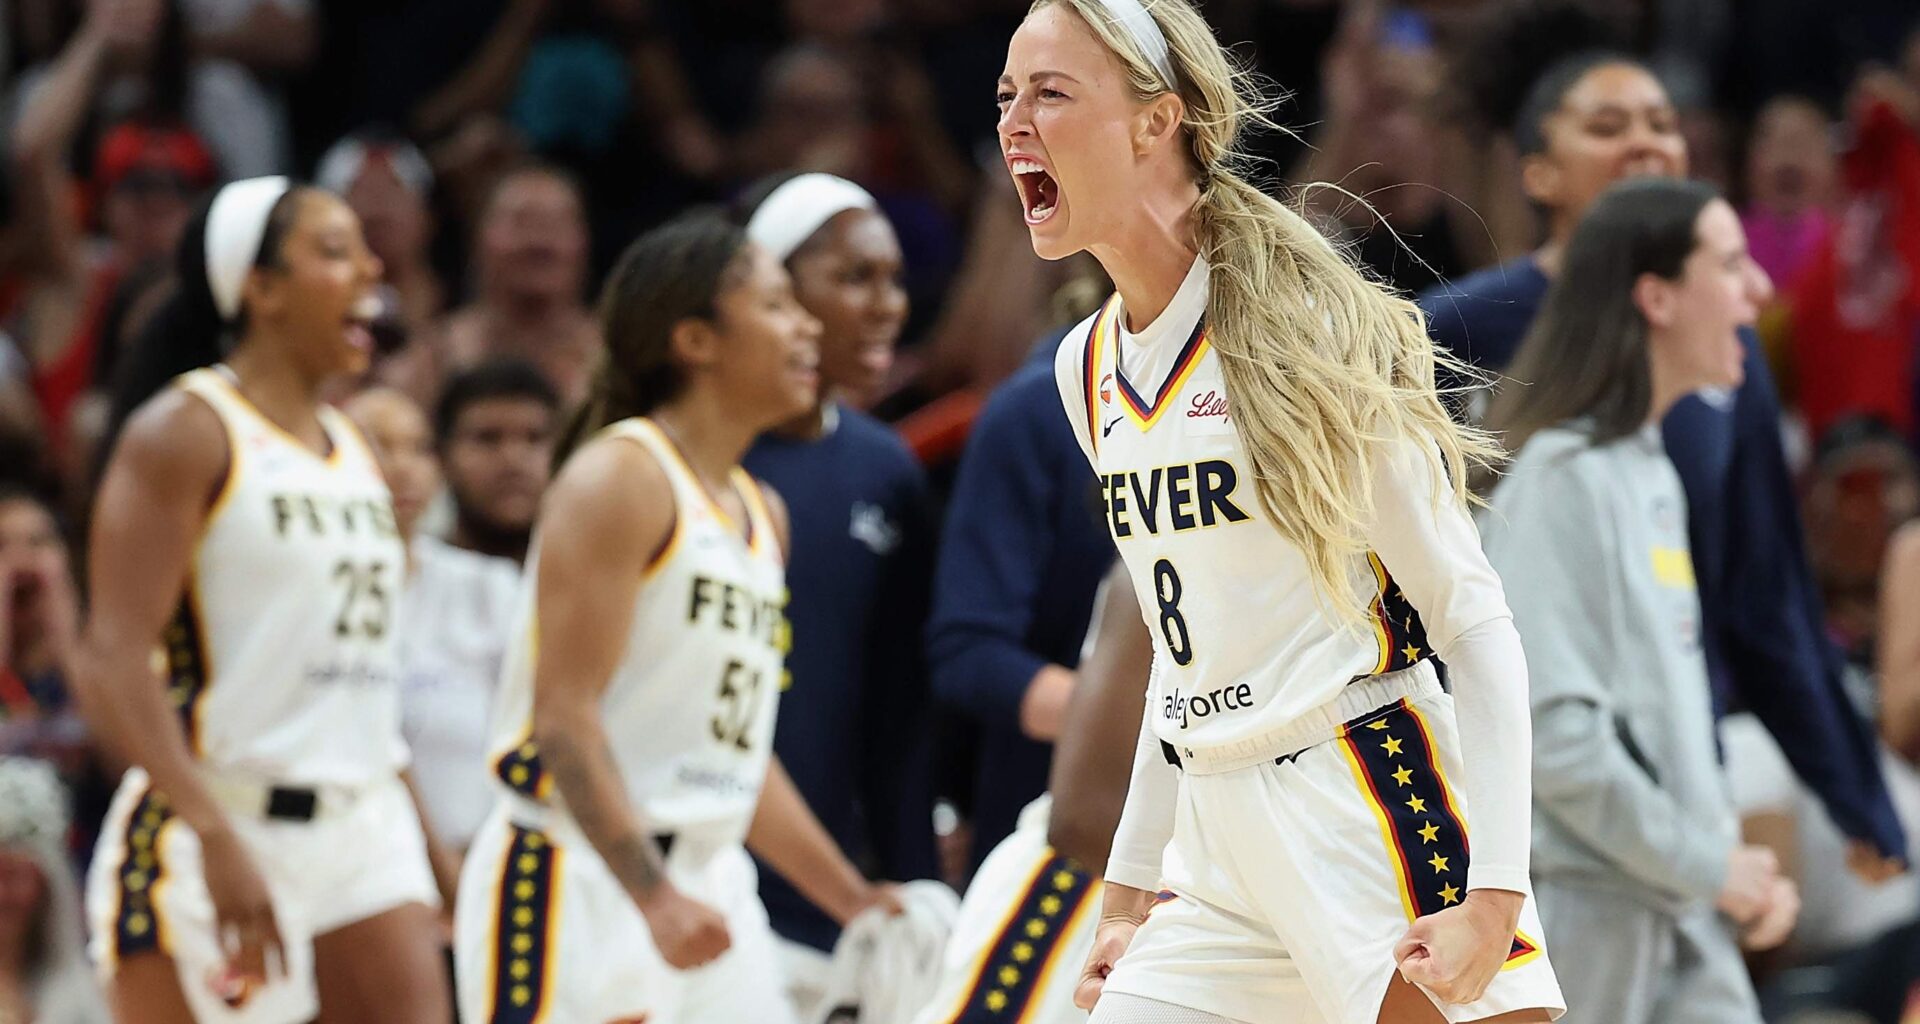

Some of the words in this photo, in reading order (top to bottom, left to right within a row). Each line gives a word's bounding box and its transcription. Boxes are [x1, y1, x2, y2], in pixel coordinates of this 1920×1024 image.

[1186, 390, 1230, 425] Lill
[333, 561, 391, 640] 25
[1153, 556, 1195, 669] 8
[709, 656, 761, 753] 52
